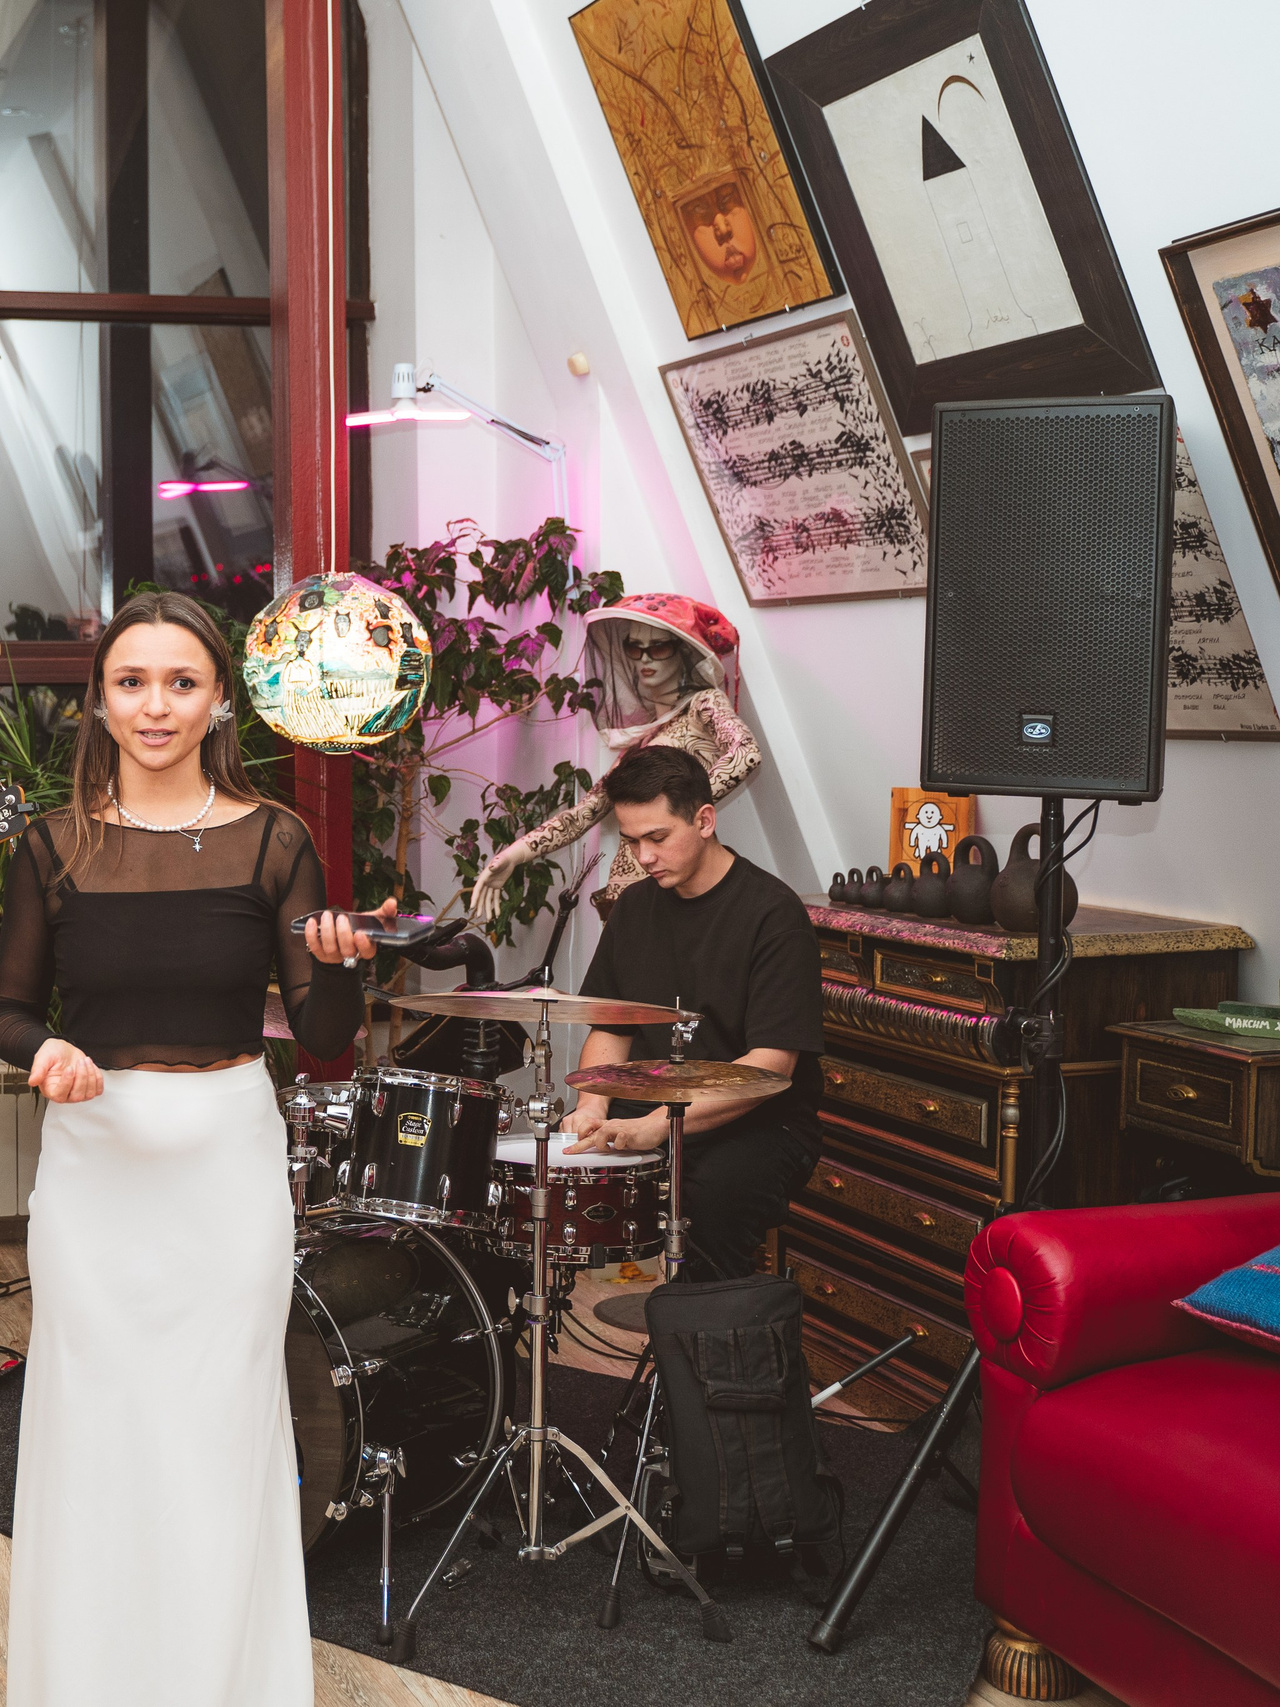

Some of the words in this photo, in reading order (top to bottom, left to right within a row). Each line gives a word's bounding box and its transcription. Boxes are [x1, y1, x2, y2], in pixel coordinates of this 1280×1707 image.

[1225, 1017, 1270, 1030] МАКСИМ
[405, 1119, 423, 1128] Stage
[402, 1125, 424, 1134] Custom
